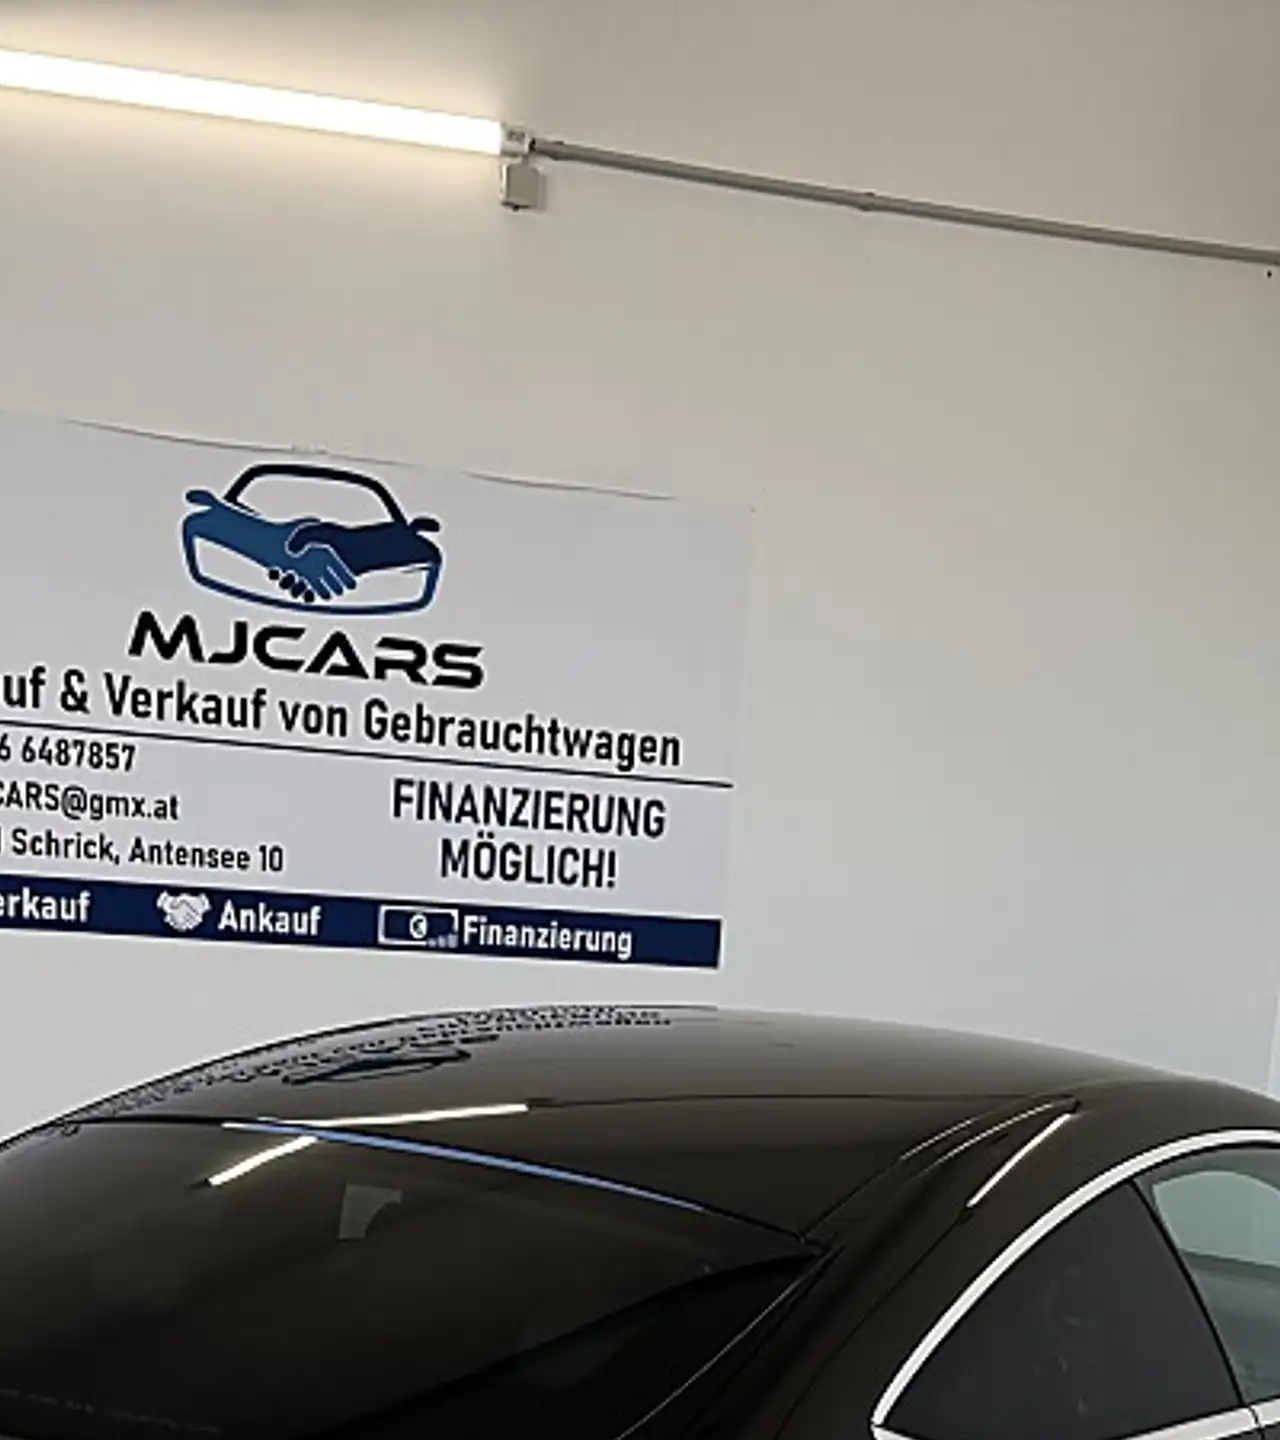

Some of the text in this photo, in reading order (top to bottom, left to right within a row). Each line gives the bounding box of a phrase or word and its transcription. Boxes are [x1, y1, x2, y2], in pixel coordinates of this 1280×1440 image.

[128, 610, 485, 689] MJCARS
[60, 668, 91, 714] &
[104, 672, 267, 731] Verkauf
[280, 701, 348, 738] von
[363, 698, 681, 771] Gebrauchtwagen
[21, 735, 136, 771] 6487857
[391, 777, 666, 838] FINANZIERUNG
[12, 828, 121, 865] Schrick,
[128, 837, 251, 870] Antensee
[259, 845, 284, 873] 10
[440, 831, 617, 889] MÖGLICH!
[218, 899, 321, 936] Ankauf
[462, 915, 633, 960] Finanzierung
